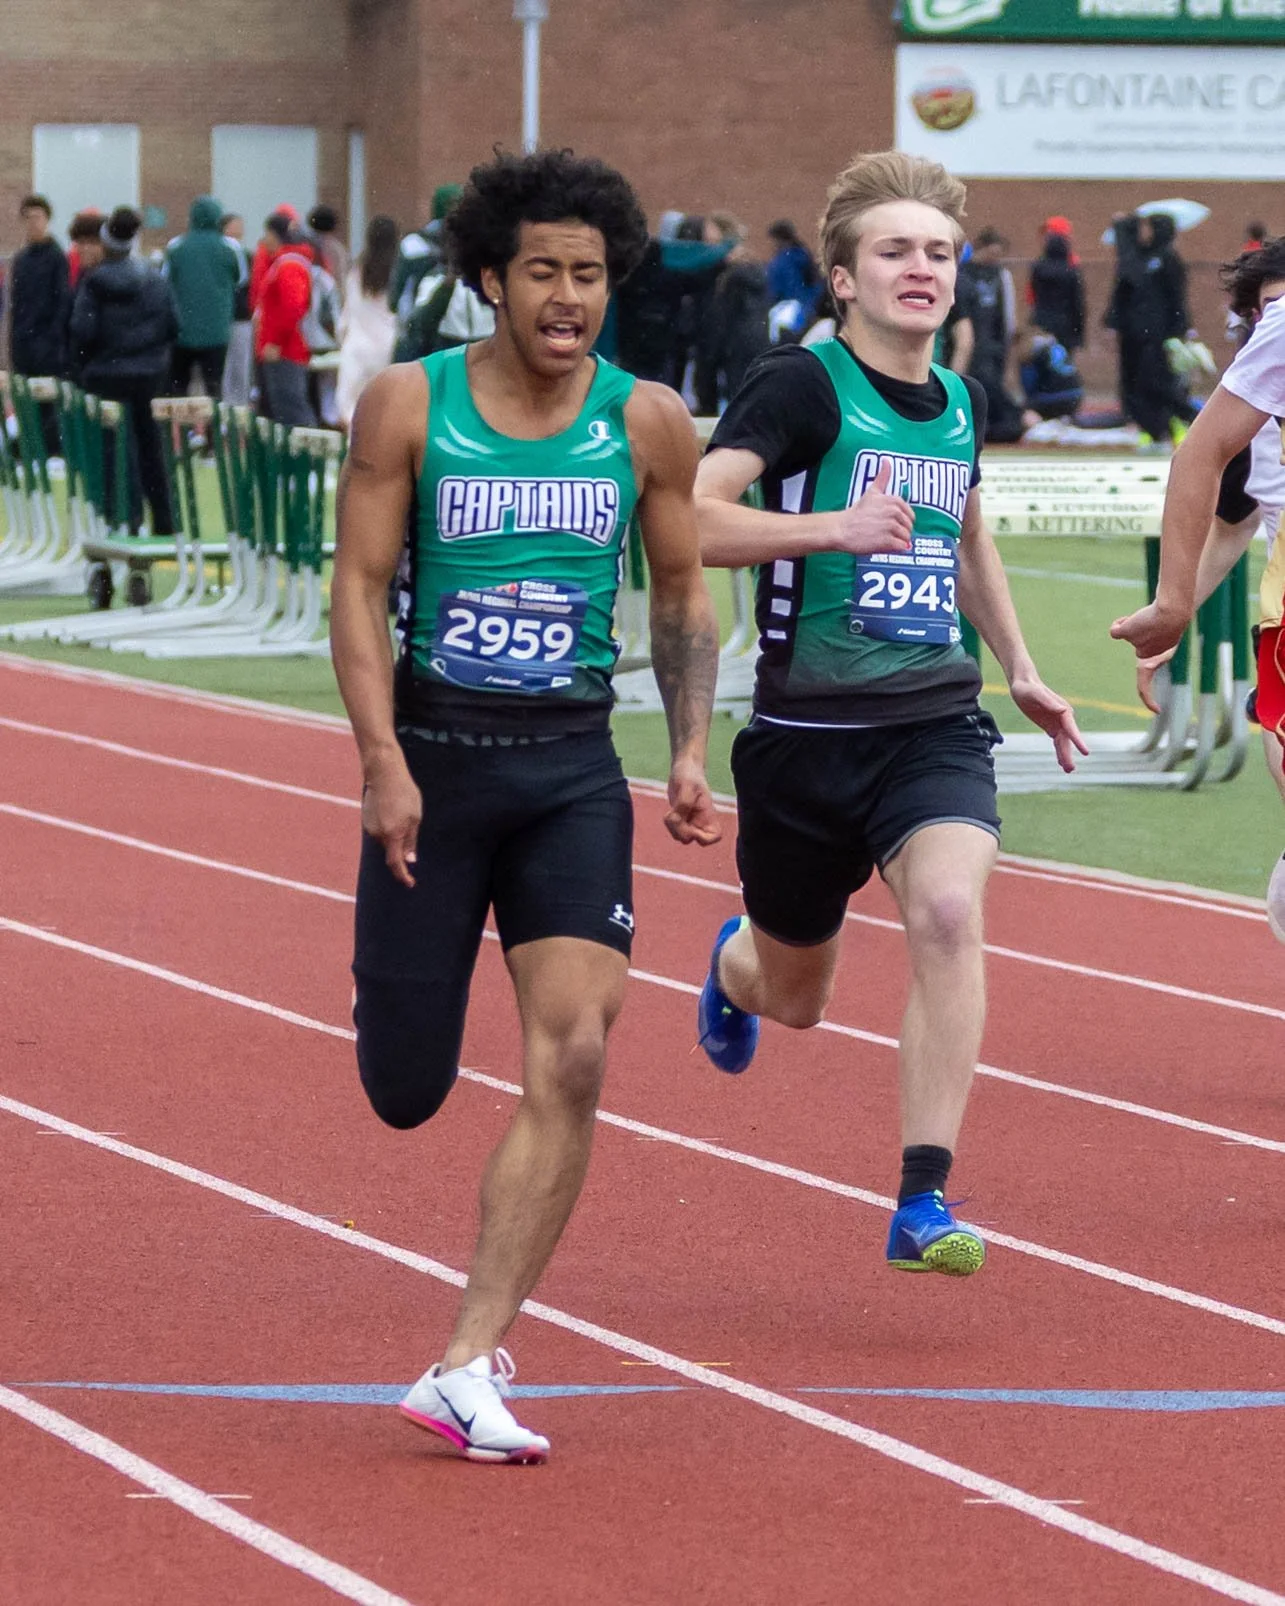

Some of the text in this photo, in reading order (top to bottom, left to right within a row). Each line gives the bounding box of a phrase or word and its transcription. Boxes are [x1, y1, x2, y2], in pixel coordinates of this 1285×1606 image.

[995, 72, 1236, 109] LAFONTAINE
[437, 475, 619, 547] CAPTAINS
[1027, 516, 1144, 533] KETTERING
[858, 571, 956, 614] 2943
[442, 608, 574, 662] 2959
